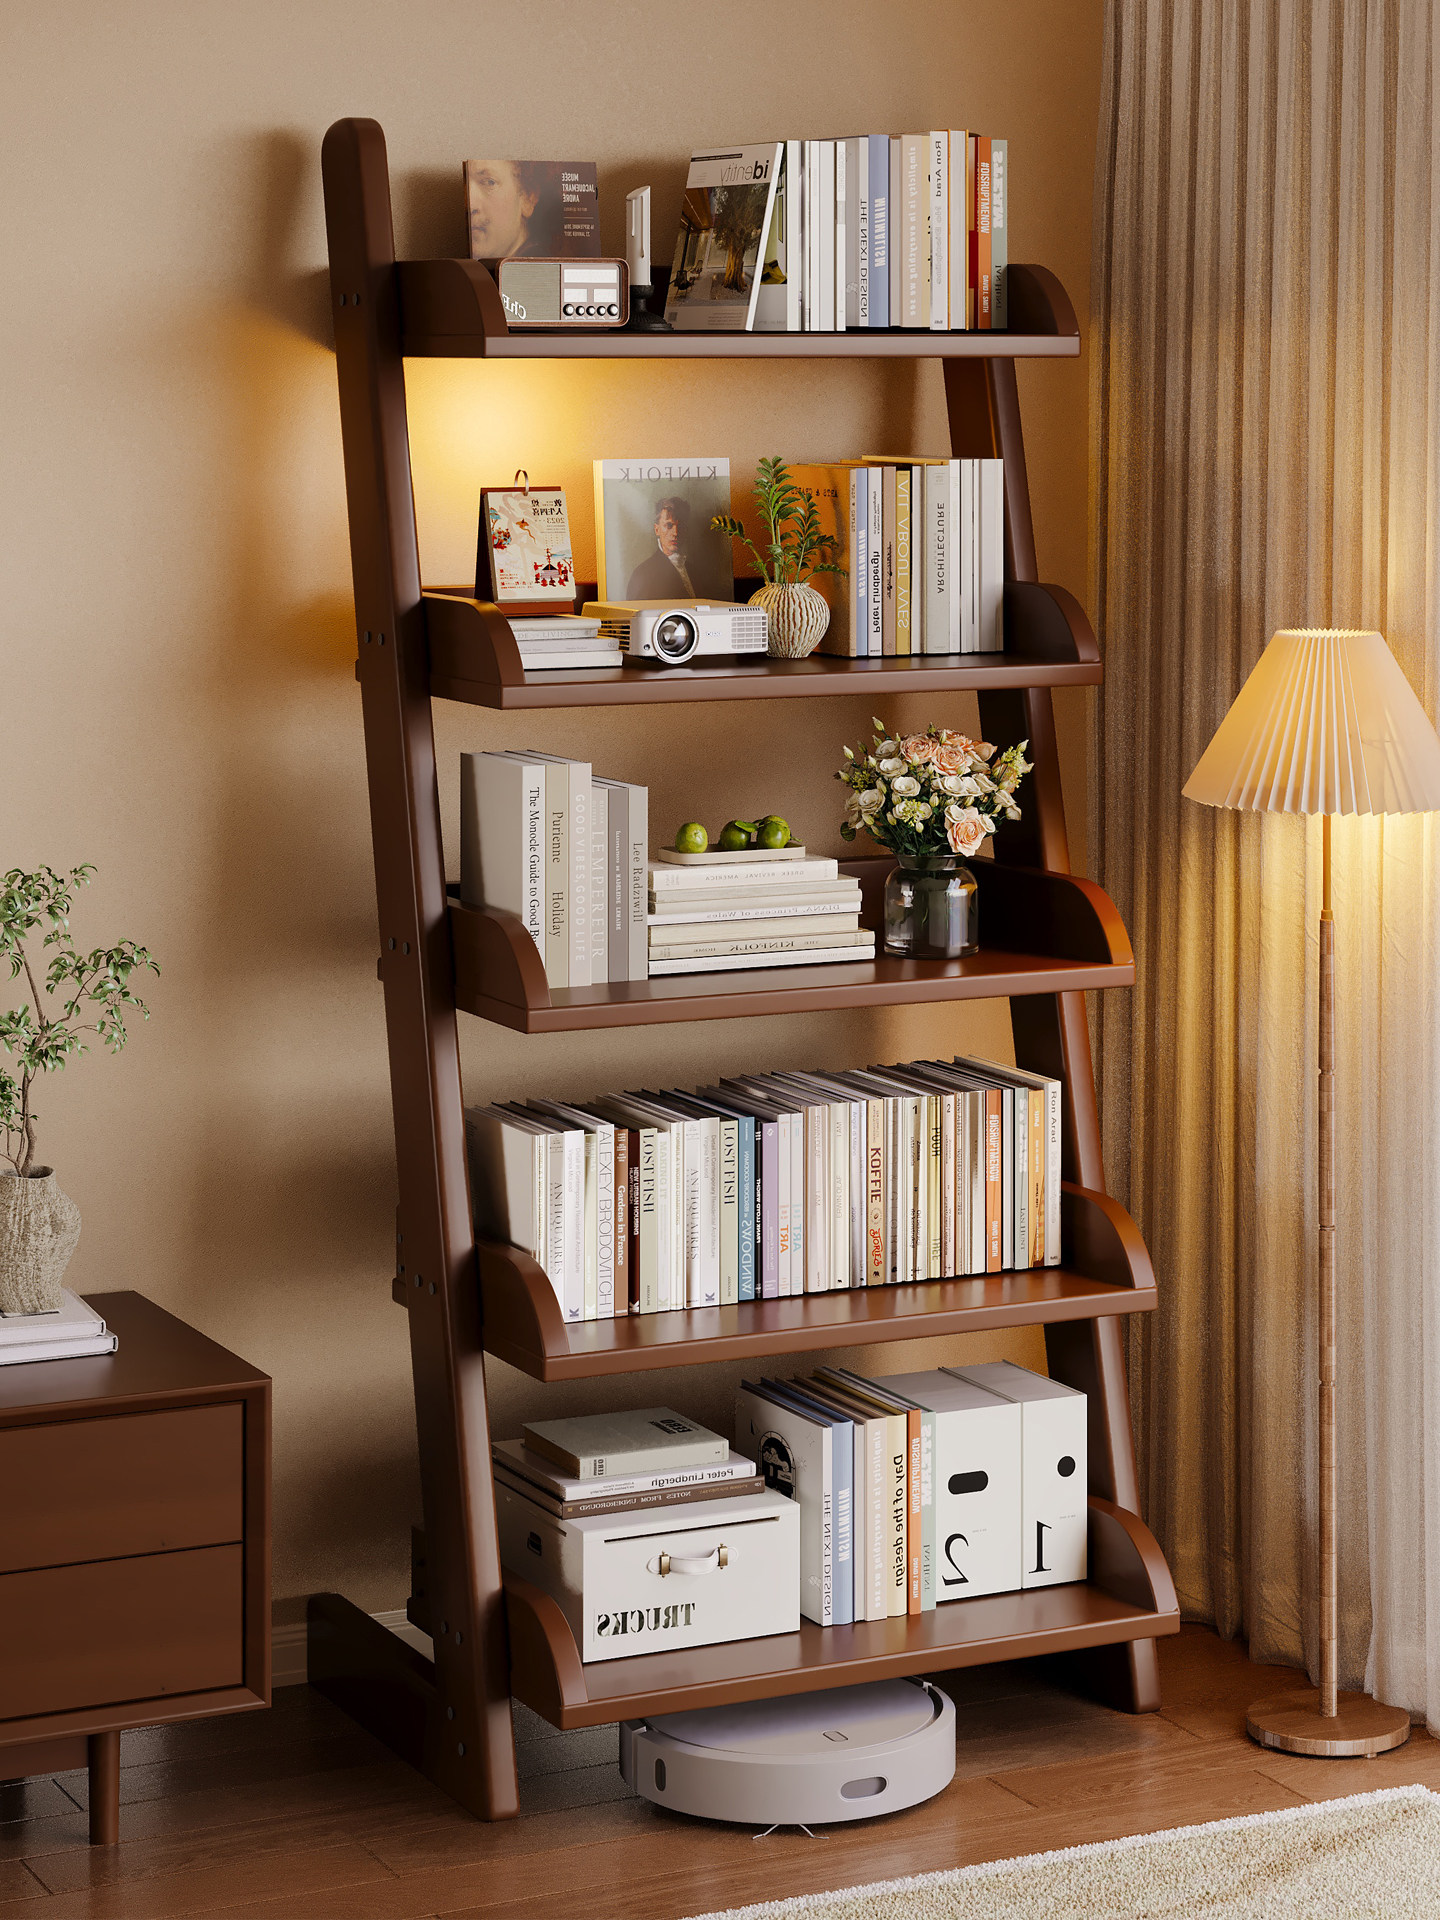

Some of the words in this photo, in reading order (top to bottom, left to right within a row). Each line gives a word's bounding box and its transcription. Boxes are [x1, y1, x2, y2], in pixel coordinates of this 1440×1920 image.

[979, 162, 990, 234] #DISRUPTMENOW
[529, 786, 540, 807] The
[575, 794, 585, 834] GOOD
[529, 809, 540, 852] Monocle
[552, 811, 564, 863] Purienne
[529, 854, 540, 884] Guide
[633, 842, 643, 862] Lee
[529, 887, 540, 897] to
[575, 884, 585, 926] GOOD
[591, 831, 604, 958] LEMPEREUR
[633, 867, 643, 922] Radziwill
[529, 899, 540, 926] Good
[548, 891, 565, 938] Holiday
[575, 931, 585, 961] LIFE
[912, 1105, 918, 1114] 1
[946, 1103, 951, 1113] 2
[599, 1130, 612, 1193] ALEXEY
[643, 1133, 655, 1174] LOST
[659, 1141, 667, 1185] MAKING
[724, 1127, 735, 1165] LOST
[989, 1114, 999, 1182] #DISRUPTMENOW
[659, 1188, 667, 1199] IT
[724, 1171, 735, 1204] FISH
[870, 1147, 882, 1203] KOFFIE
[617, 1184, 626, 1223] Gardens
[643, 1178, 655, 1213] FISH
[689, 1168, 699, 1260] ANTIQUAIRES
[552, 1182, 563, 1275] ANTIQUAIRES
[617, 1224, 626, 1233] in
[599, 1199, 612, 1306] BRODOVITCH
[617, 1235, 626, 1266] France
